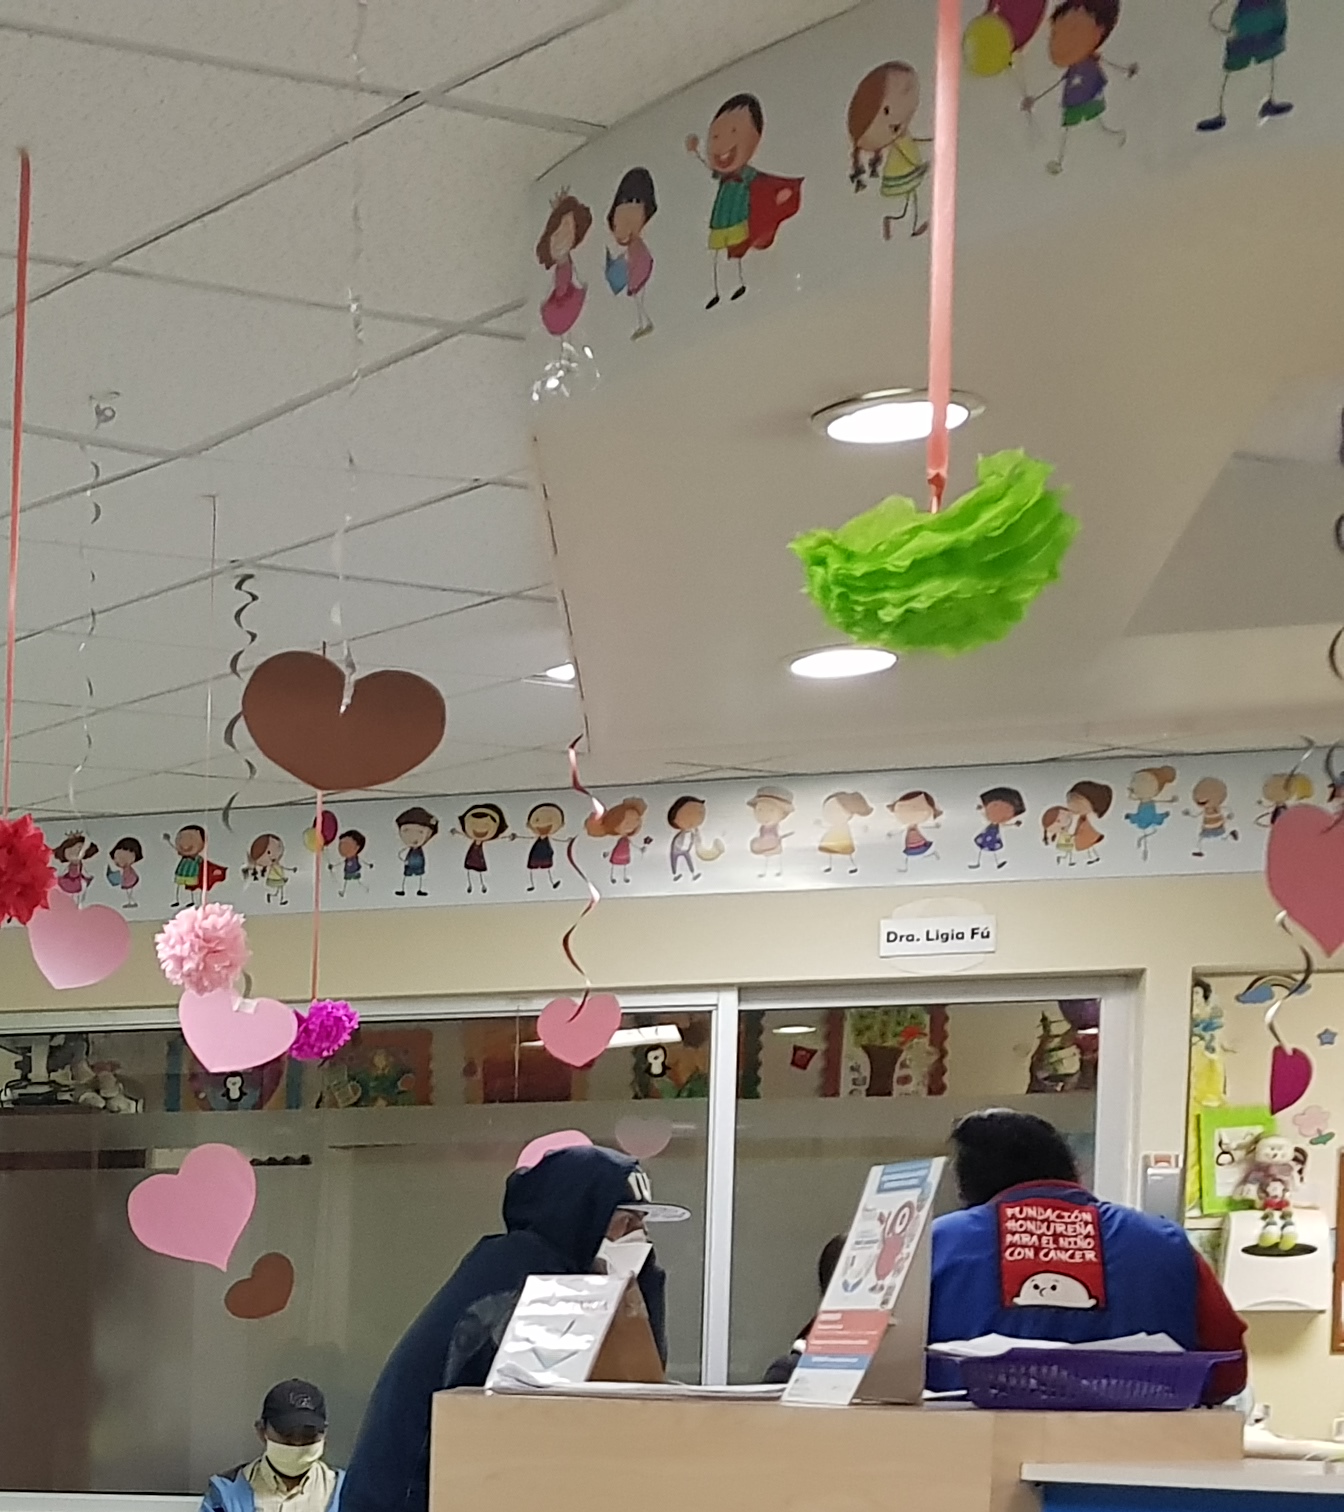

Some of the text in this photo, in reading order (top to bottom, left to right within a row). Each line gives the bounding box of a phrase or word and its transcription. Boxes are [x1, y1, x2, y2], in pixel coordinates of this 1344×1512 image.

[886, 927, 990, 943] Dra. Ligia Fú
[1005, 1206, 1092, 1222] FUNDACIÓN
[1006, 1219, 1094, 1236] HONDUREÑA
[1006, 1234, 1094, 1249] PARA EL NIÑO
[1005, 1247, 1034, 1260] CON
